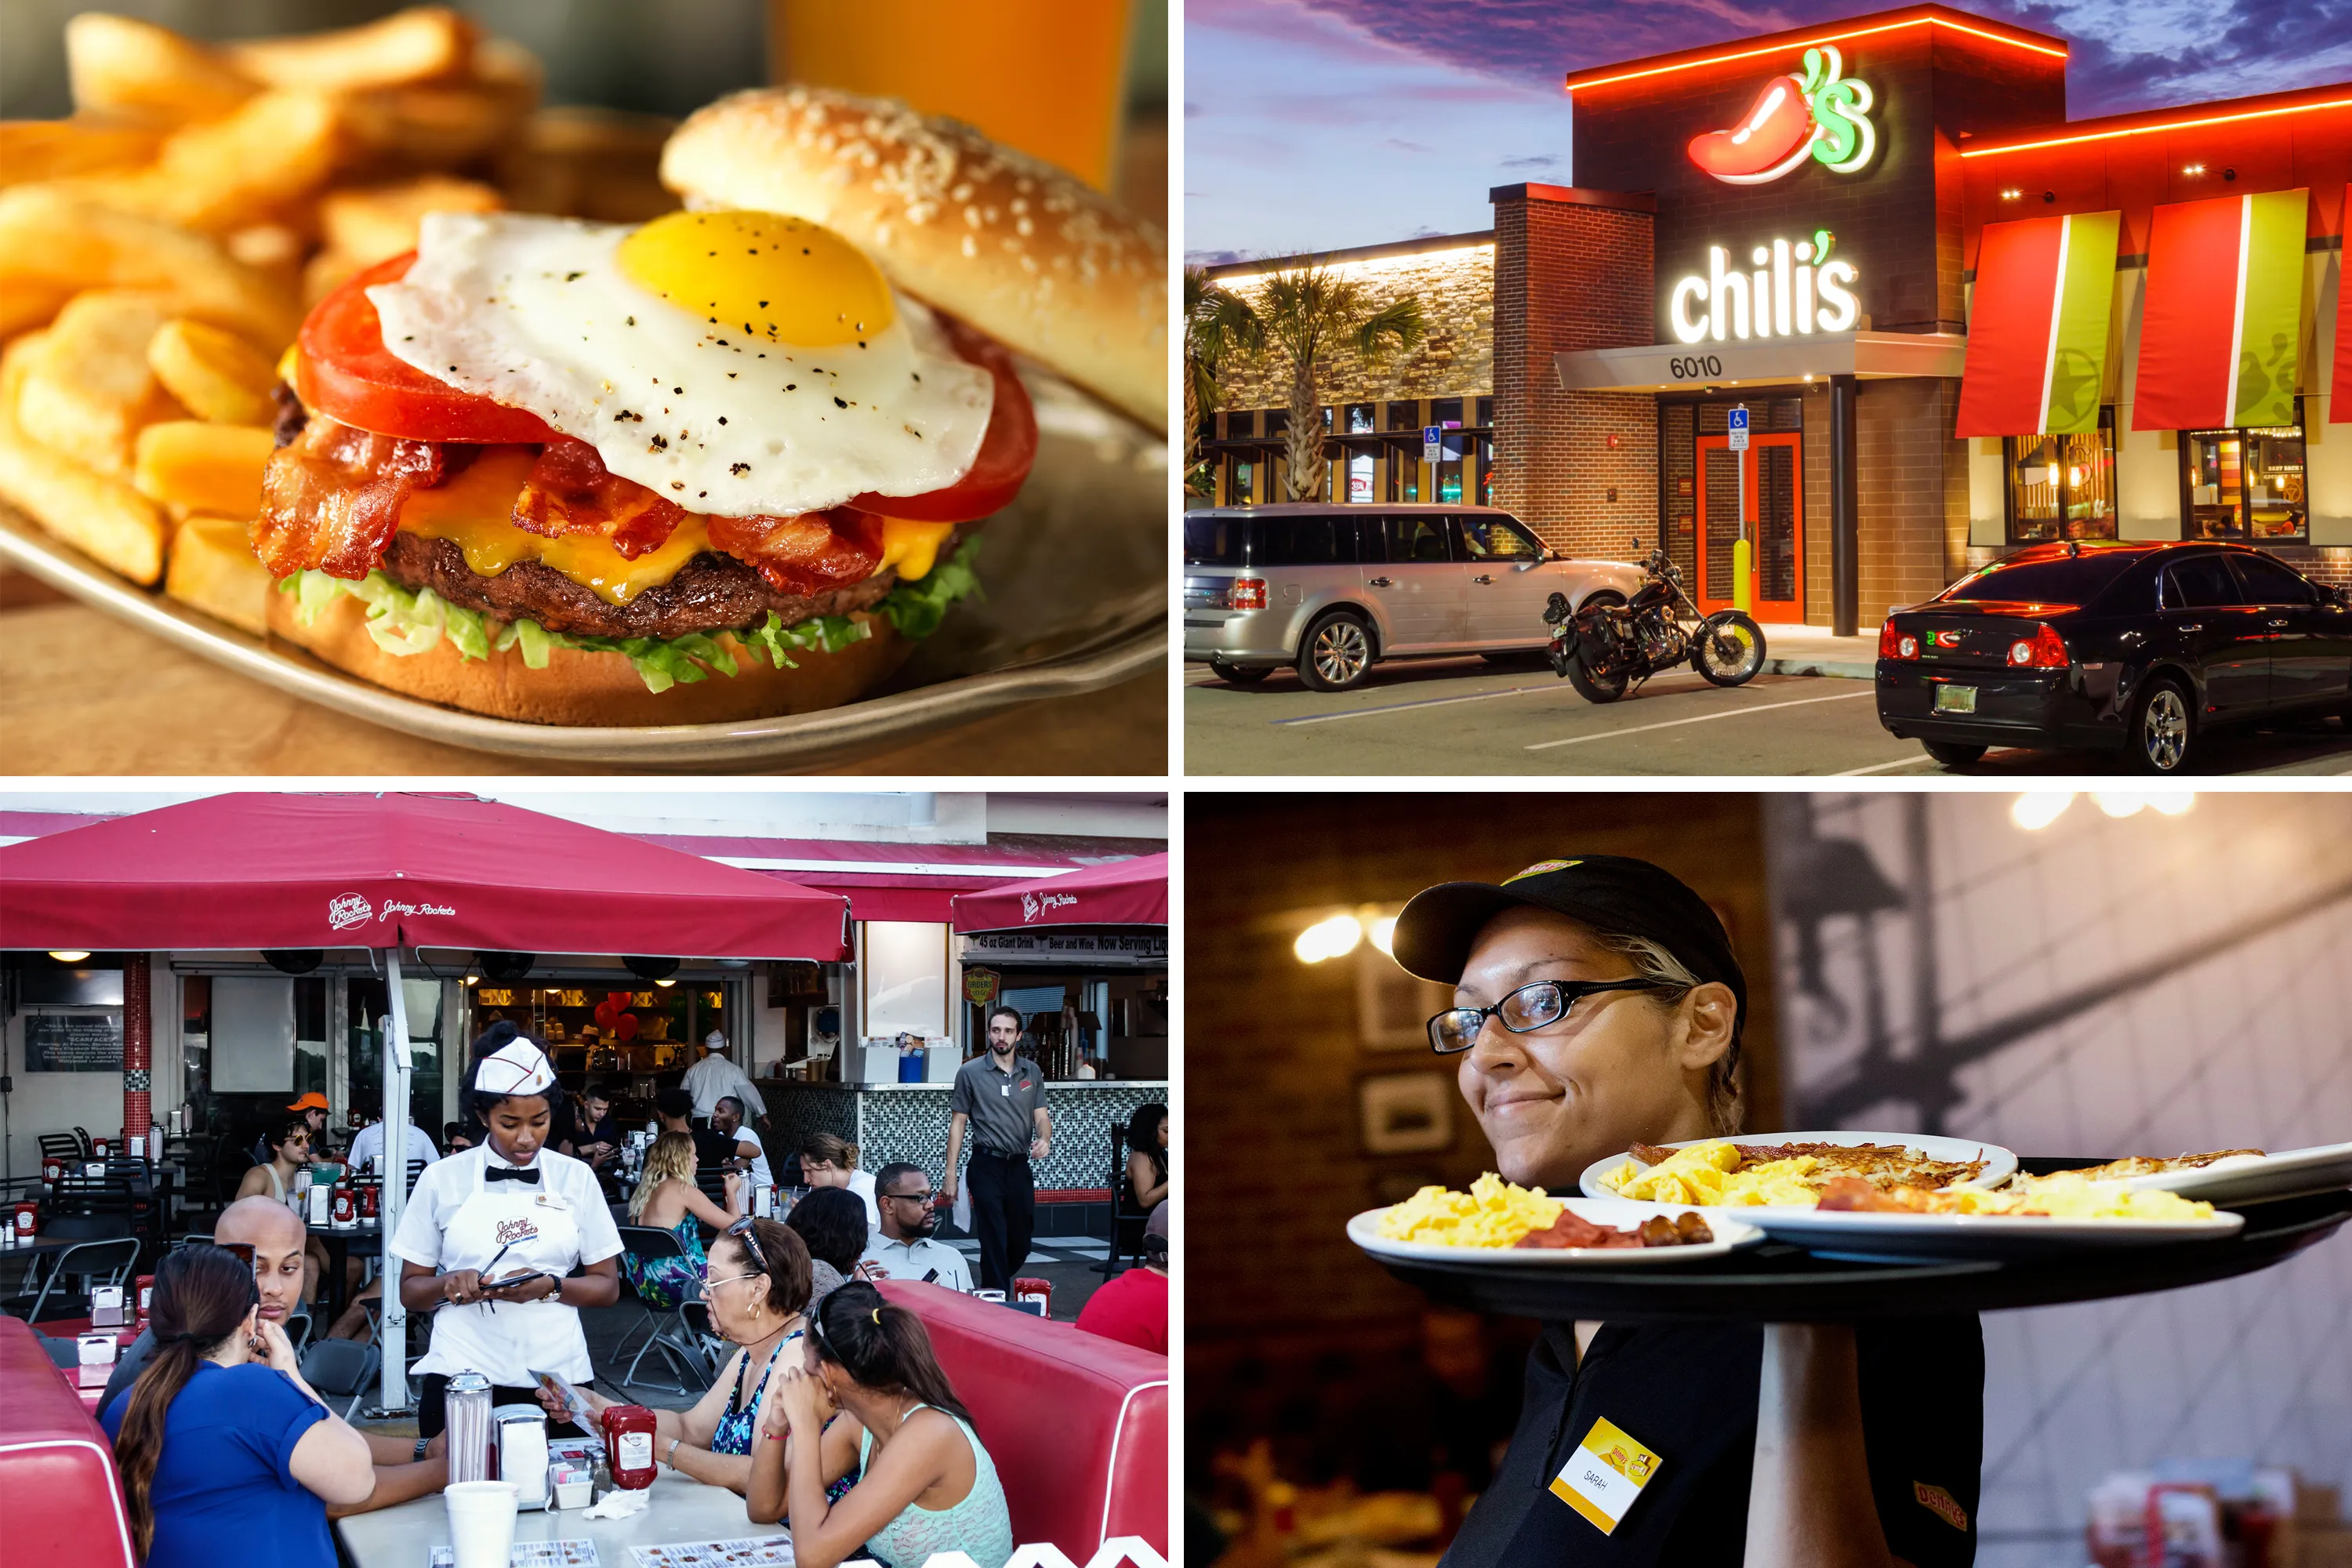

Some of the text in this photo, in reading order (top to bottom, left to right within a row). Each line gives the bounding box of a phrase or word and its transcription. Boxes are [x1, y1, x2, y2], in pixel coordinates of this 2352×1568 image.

[1671, 230, 1860, 343] chili's
[1670, 355, 1722, 379] 6010
[329, 895, 365, 924] Johnny
[334, 902, 372, 924] Rockets
[379, 899, 416, 922] Johnny
[416, 903, 456, 916] Rockets
[979, 936, 988, 948] 45
[989, 940, 997, 949] oz
[998, 936, 1016, 949] Giant
[1017, 937, 1034, 949] Drink
[1049, 937, 1064, 949] Beer
[1065, 938, 1077, 949] and
[1079, 937, 1094, 950] Wine
[1098, 936, 1117, 950] Now
[1119, 936, 1152, 955] Serving
[496, 1218, 532, 1243] Johnny
[502, 1225, 539, 1244] Rockets
[1612, 1447, 1628, 1465] Denny's
[1584, 1470, 1609, 1491] SARAH
[1918, 1486, 1965, 1527] Denny's
